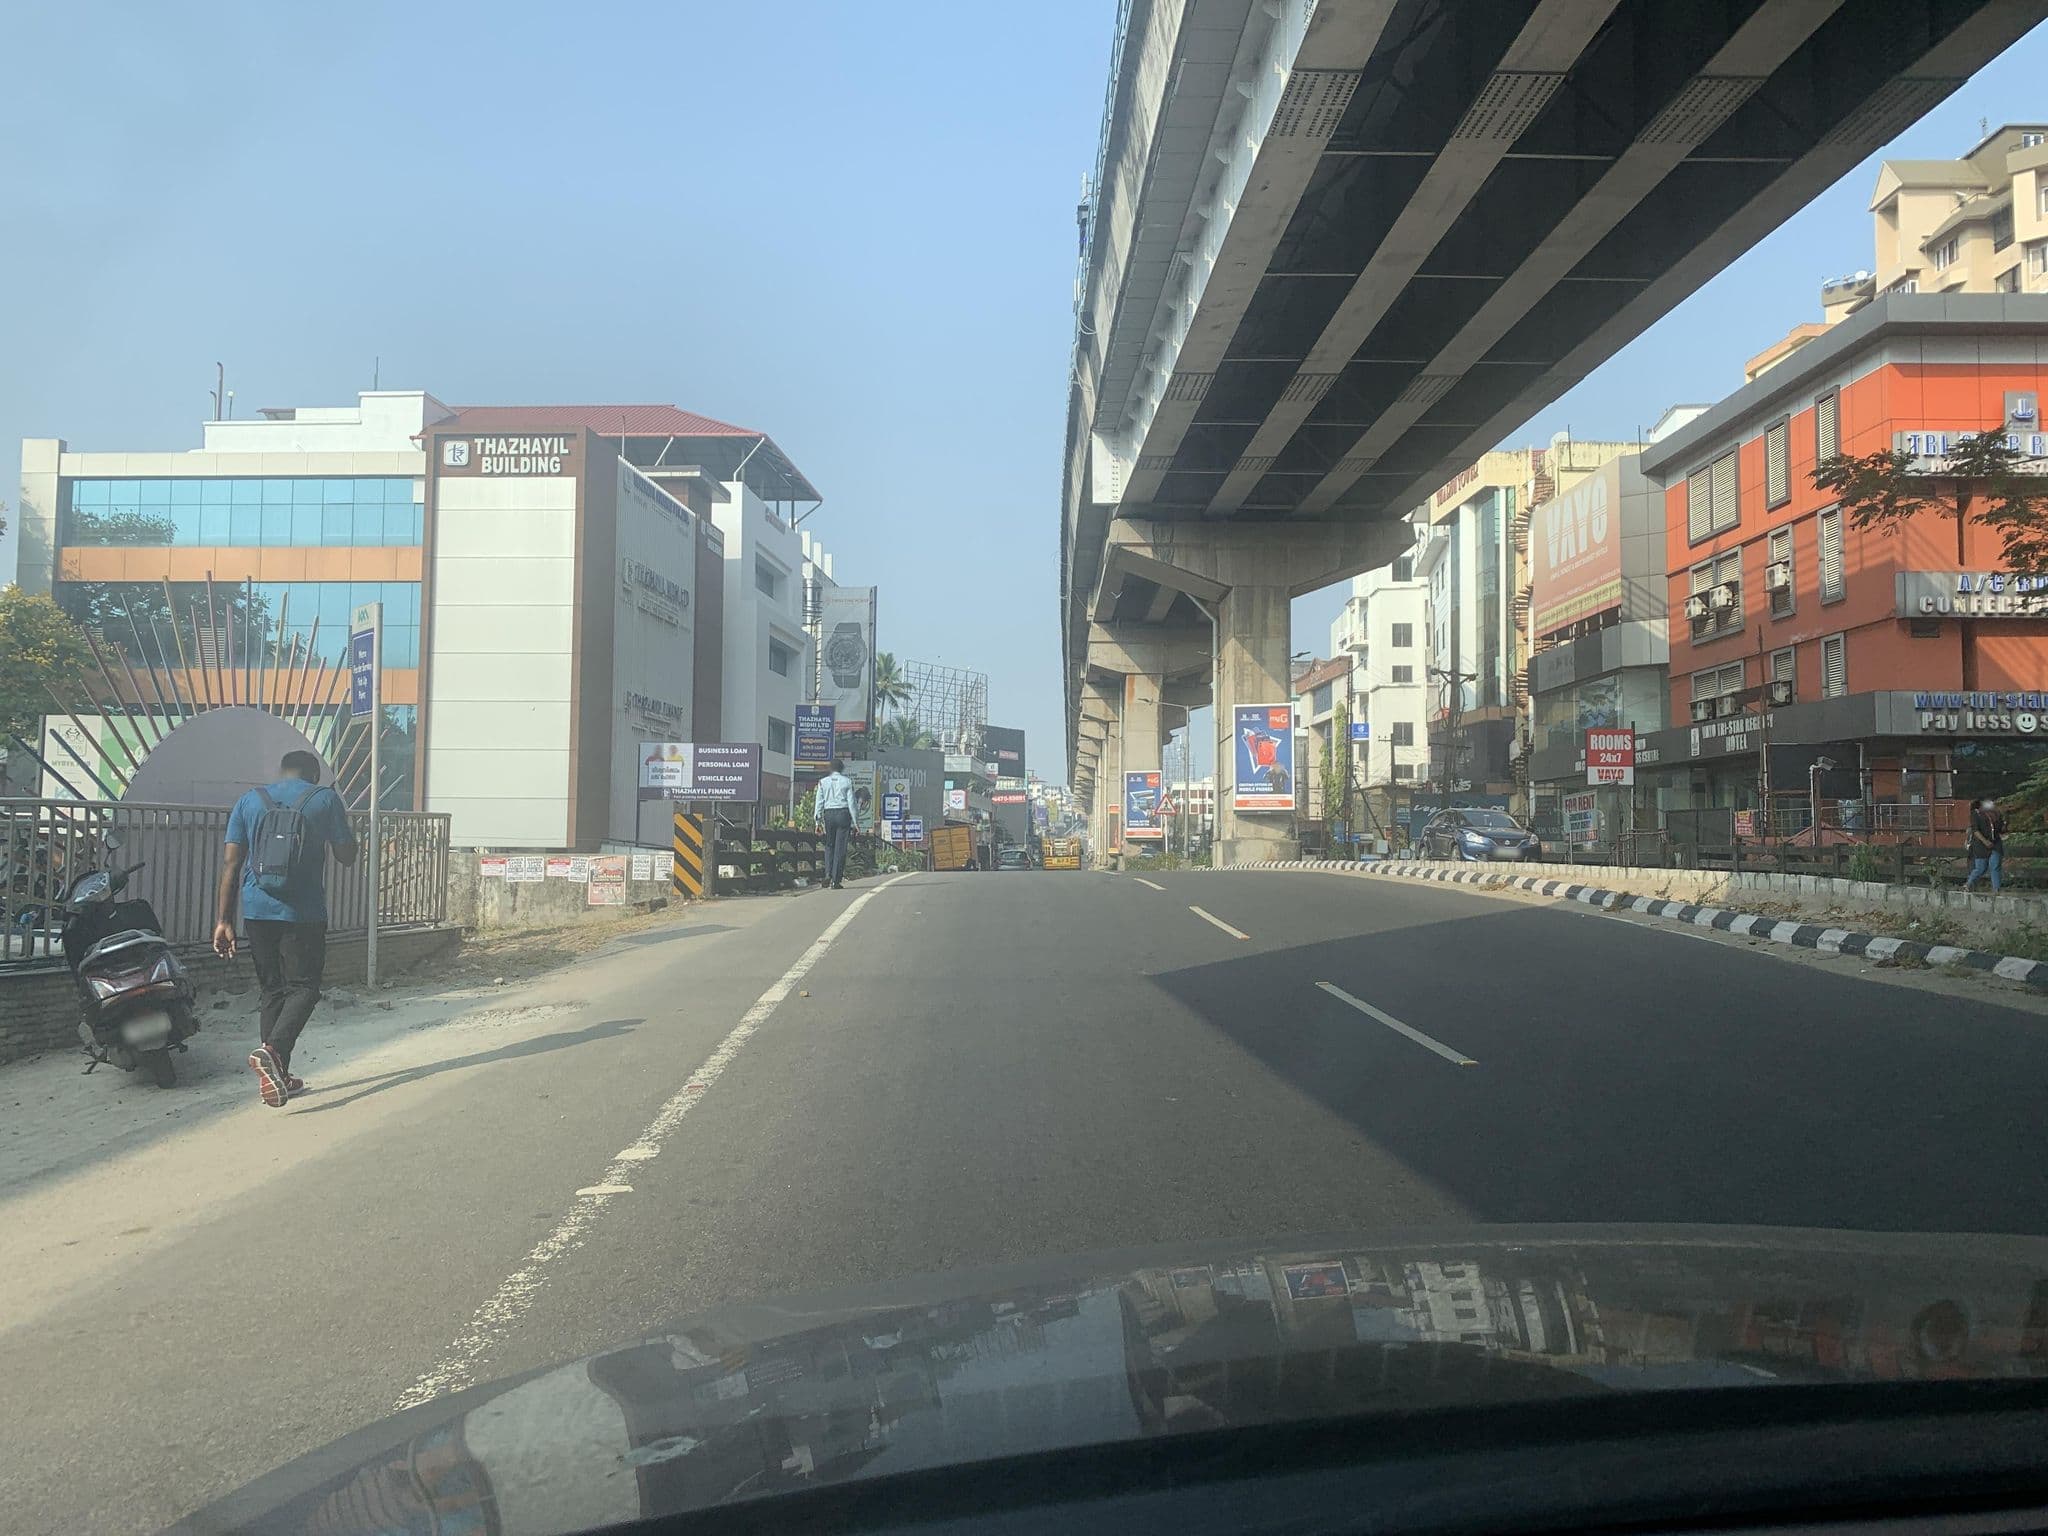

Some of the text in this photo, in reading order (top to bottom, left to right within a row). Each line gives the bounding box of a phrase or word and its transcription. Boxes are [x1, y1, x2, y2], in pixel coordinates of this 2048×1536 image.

[474, 438, 569, 455] THAZHAYIL
[481, 456, 561, 474] BUILDING
[1546, 475, 1608, 569] VAYO
[1921, 712, 1959, 731] Pay
[1966, 712, 2012, 730] less
[1590, 734, 1632, 750] ROOMS
[1725, 733, 1748, 752] HOTEL
[1600, 752, 1622, 763] 24x7
[1577, 794, 1595, 811] RENT
